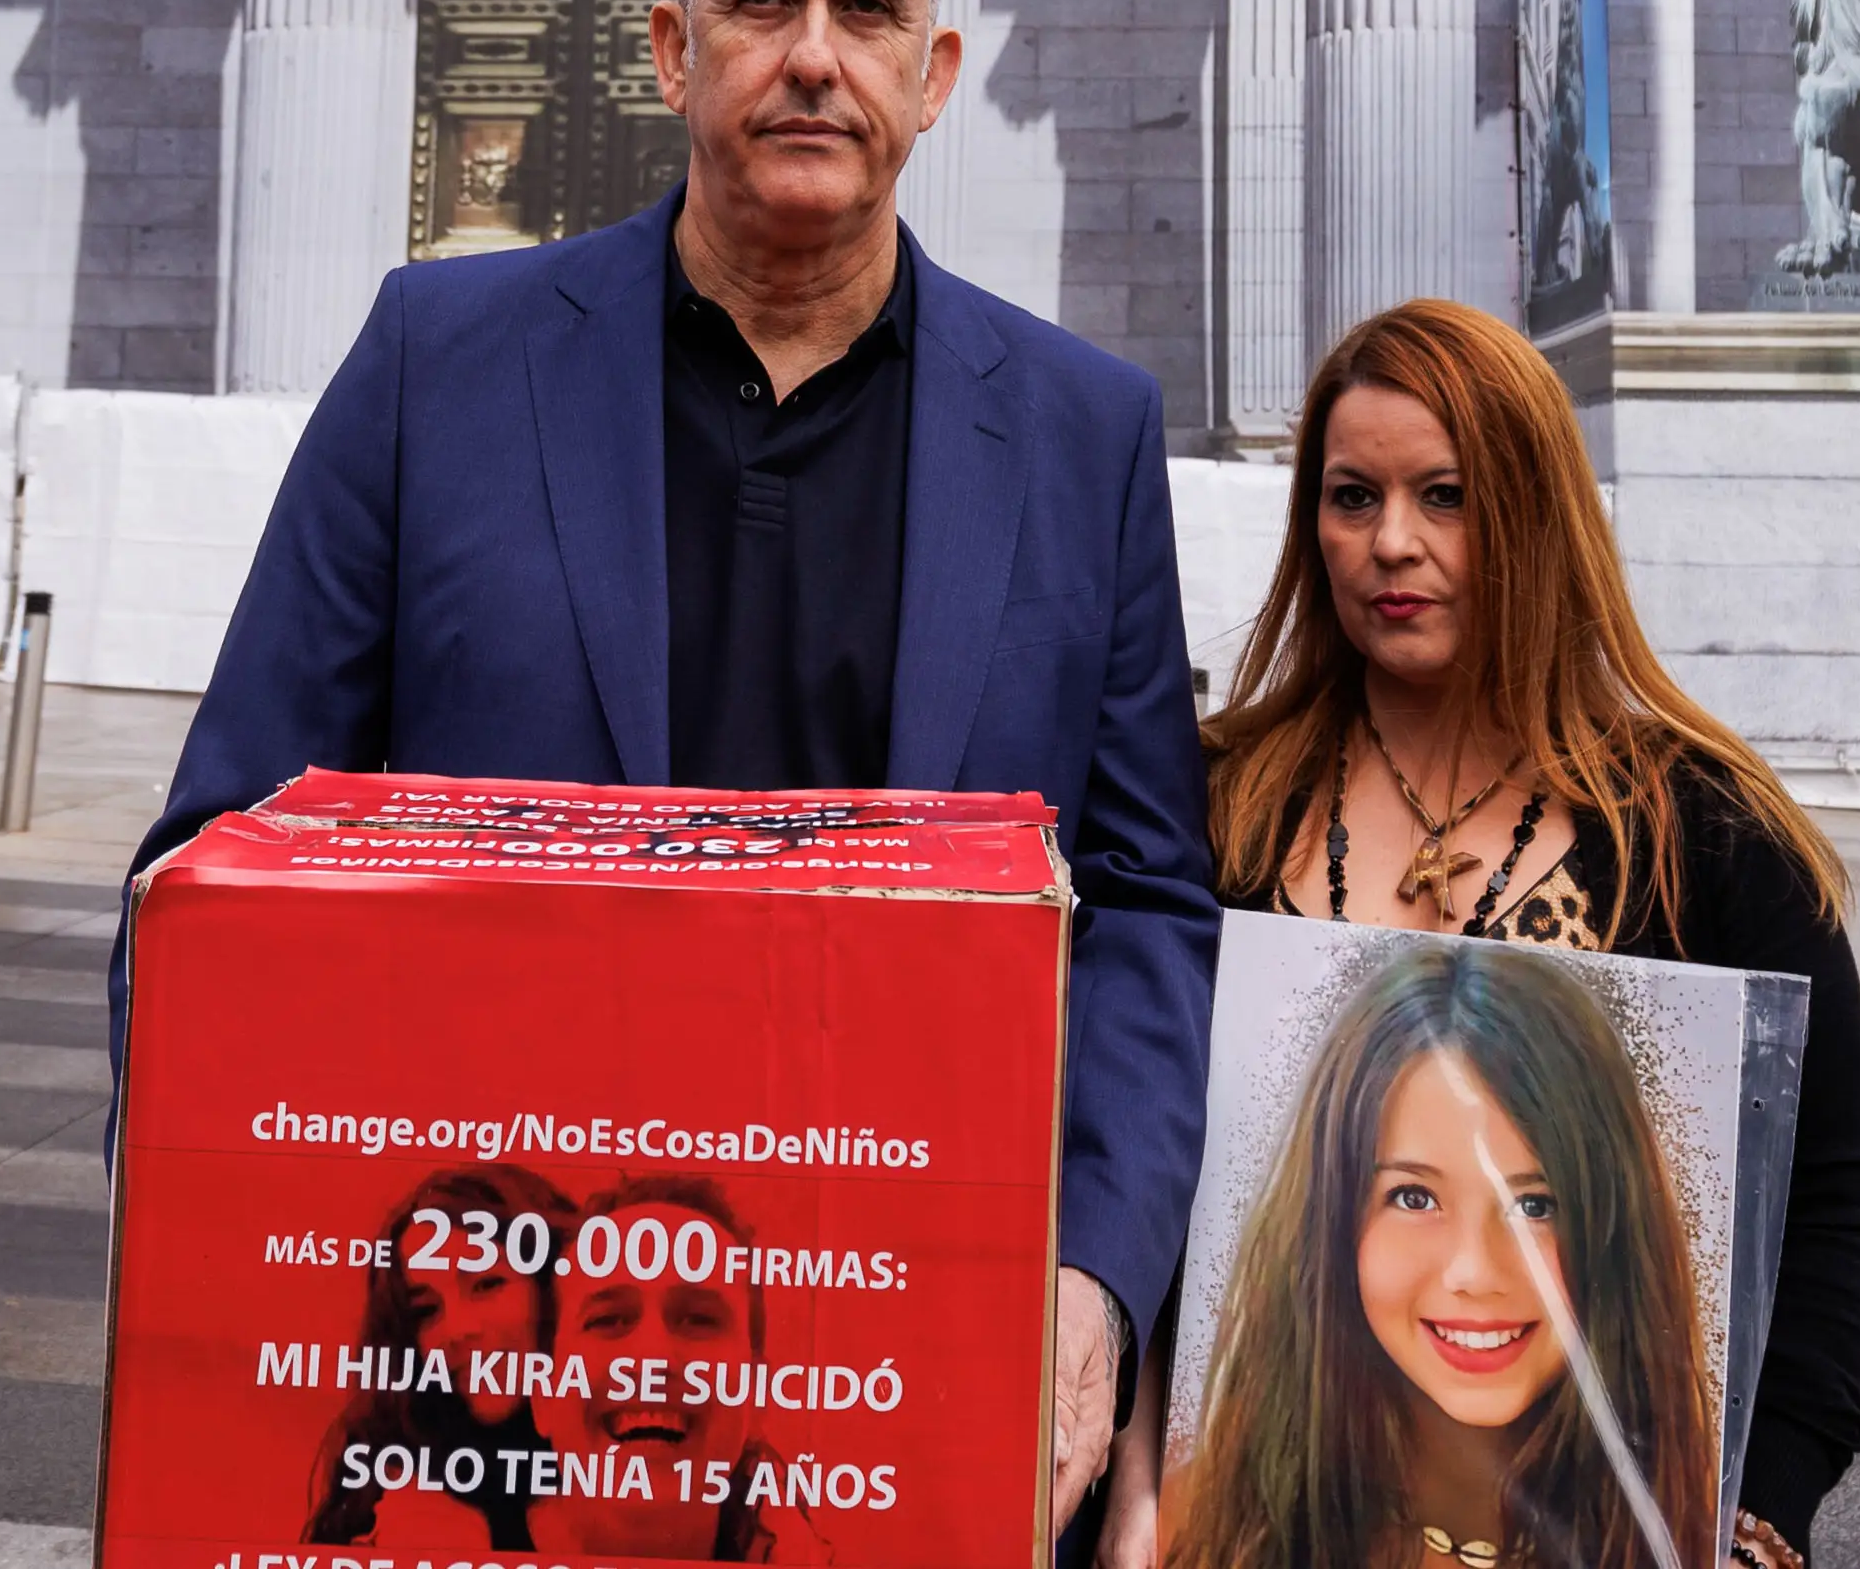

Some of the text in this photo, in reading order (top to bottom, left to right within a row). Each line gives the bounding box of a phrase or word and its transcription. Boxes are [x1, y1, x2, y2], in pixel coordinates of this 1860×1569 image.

[389, 792, 451, 802] YA!
[460, 795, 642, 812] ESCOLAR
[378, 804, 511, 817] AÑOS
[651, 803, 791, 813] ACOSO
[519, 811, 569, 822] 15
[728, 810, 847, 823] SOLO
[327, 836, 498, 849] FIRMAS:
[501, 838, 784, 856] 230.000
[796, 837, 836, 848] DE
[251, 1101, 930, 1170] change.org/NoEsCosaDeNiños
[264, 1208, 908, 1291] MÁS DE 230.000 FIRMAS:
[256, 1341, 903, 1412] MI HIJA KIRA SE SUICIDÓ
[341, 1443, 897, 1510] SOLO TENÍA 15 AÑOS
